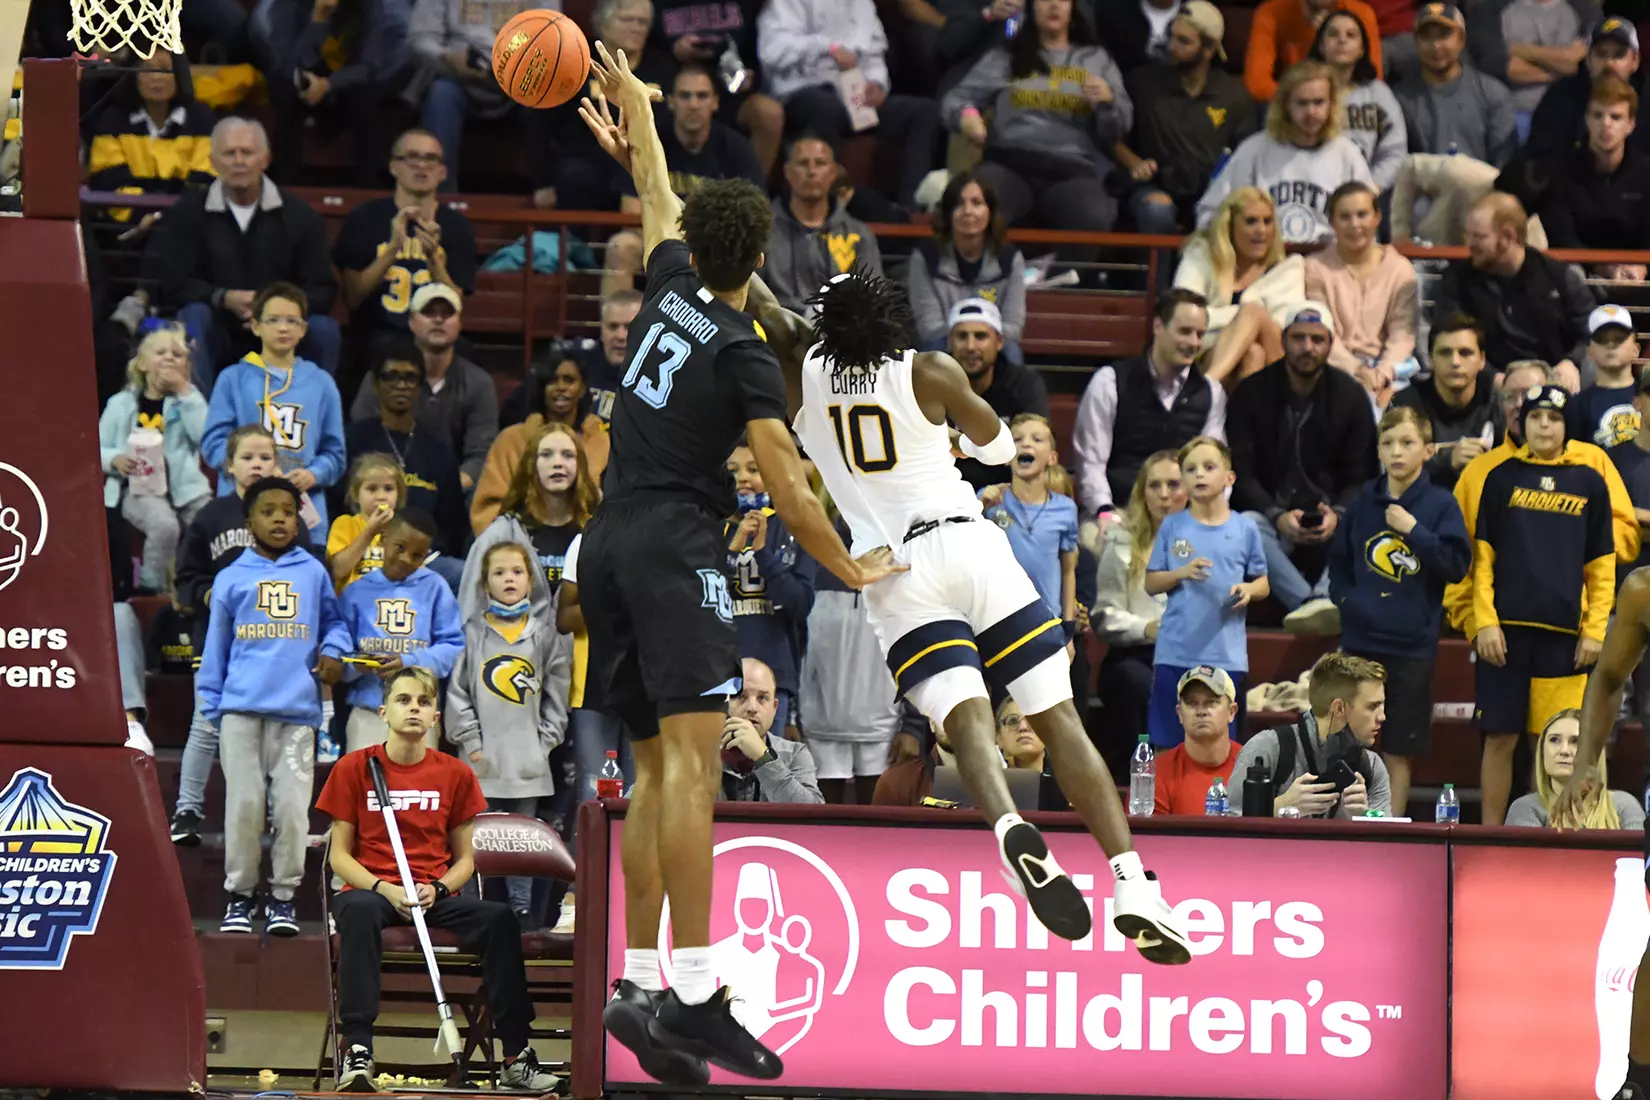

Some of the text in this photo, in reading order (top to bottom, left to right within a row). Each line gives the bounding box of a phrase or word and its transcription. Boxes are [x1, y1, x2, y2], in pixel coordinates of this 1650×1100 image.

[658, 290, 719, 345] IGHODARO
[621, 322, 692, 410] 13
[830, 371, 878, 395] CURRY
[827, 403, 898, 475] 10
[1509, 486, 1588, 516] MARQUETTE
[209, 527, 257, 560] MARQU
[256, 580, 301, 621] MU
[374, 598, 418, 636] MU
[367, 790, 441, 812] ESPN
[471, 835, 554, 853] CHARLESTON
[477, 827, 541, 844] COLLEGE of
[0, 874, 92, 906] ston
